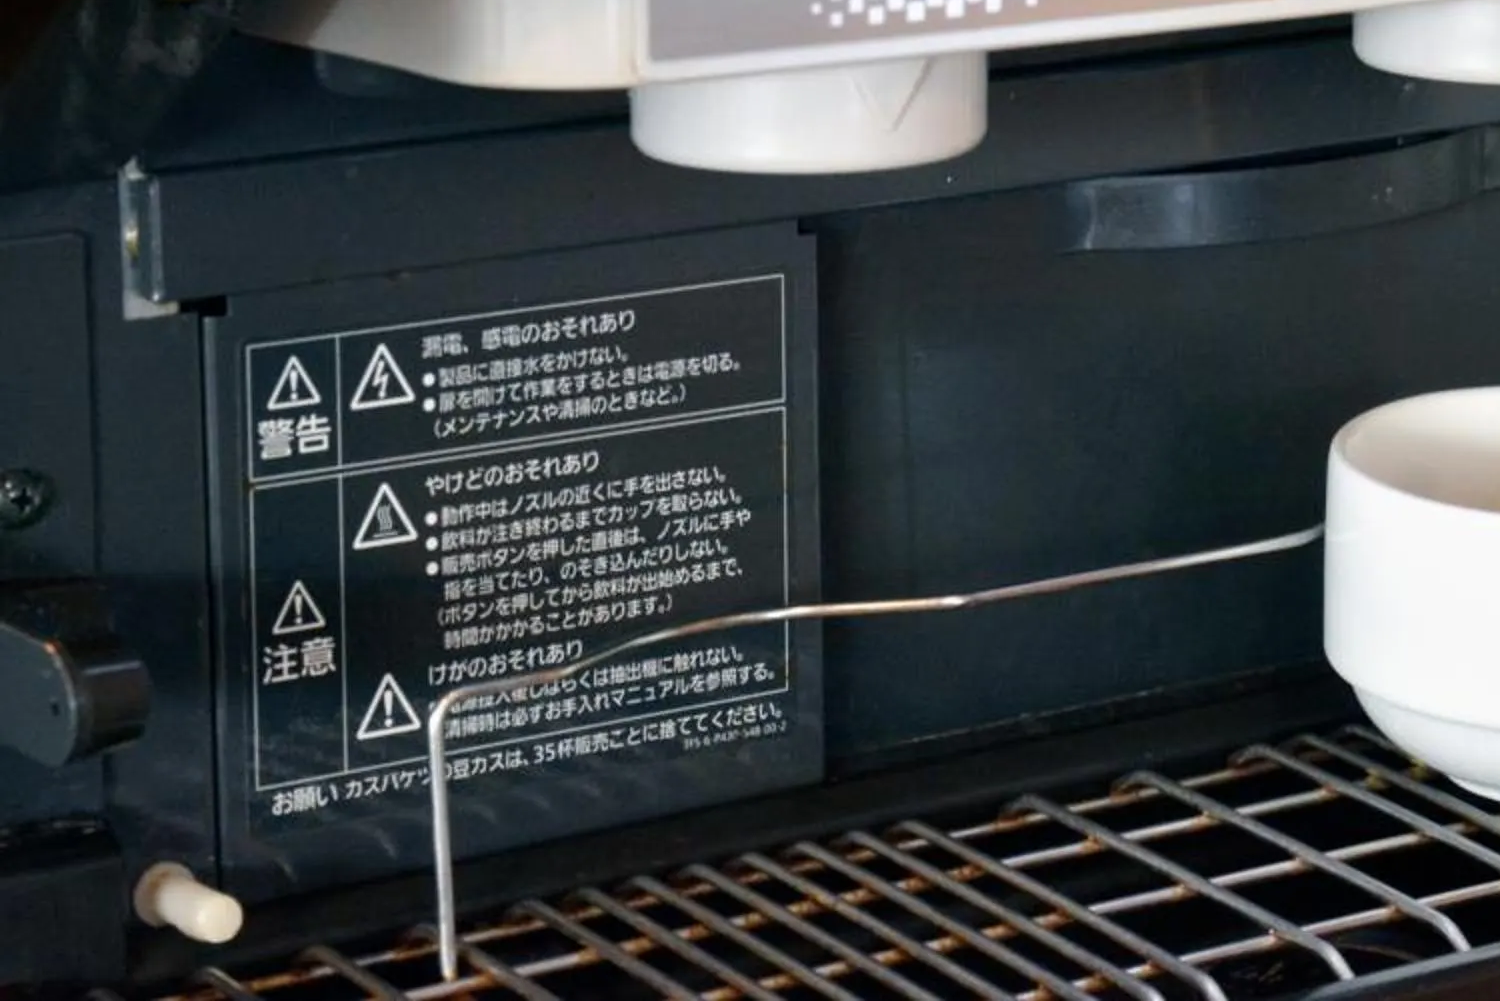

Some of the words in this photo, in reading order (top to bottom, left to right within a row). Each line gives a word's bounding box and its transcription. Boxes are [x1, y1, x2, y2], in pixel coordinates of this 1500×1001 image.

[257, 413, 332, 460] 警告
[425, 450, 600, 497] やけどのおそれあり
[263, 636, 337, 686] 注意
[428, 640, 584, 687] けがのおそれあり
[271, 782, 339, 816] お願い
